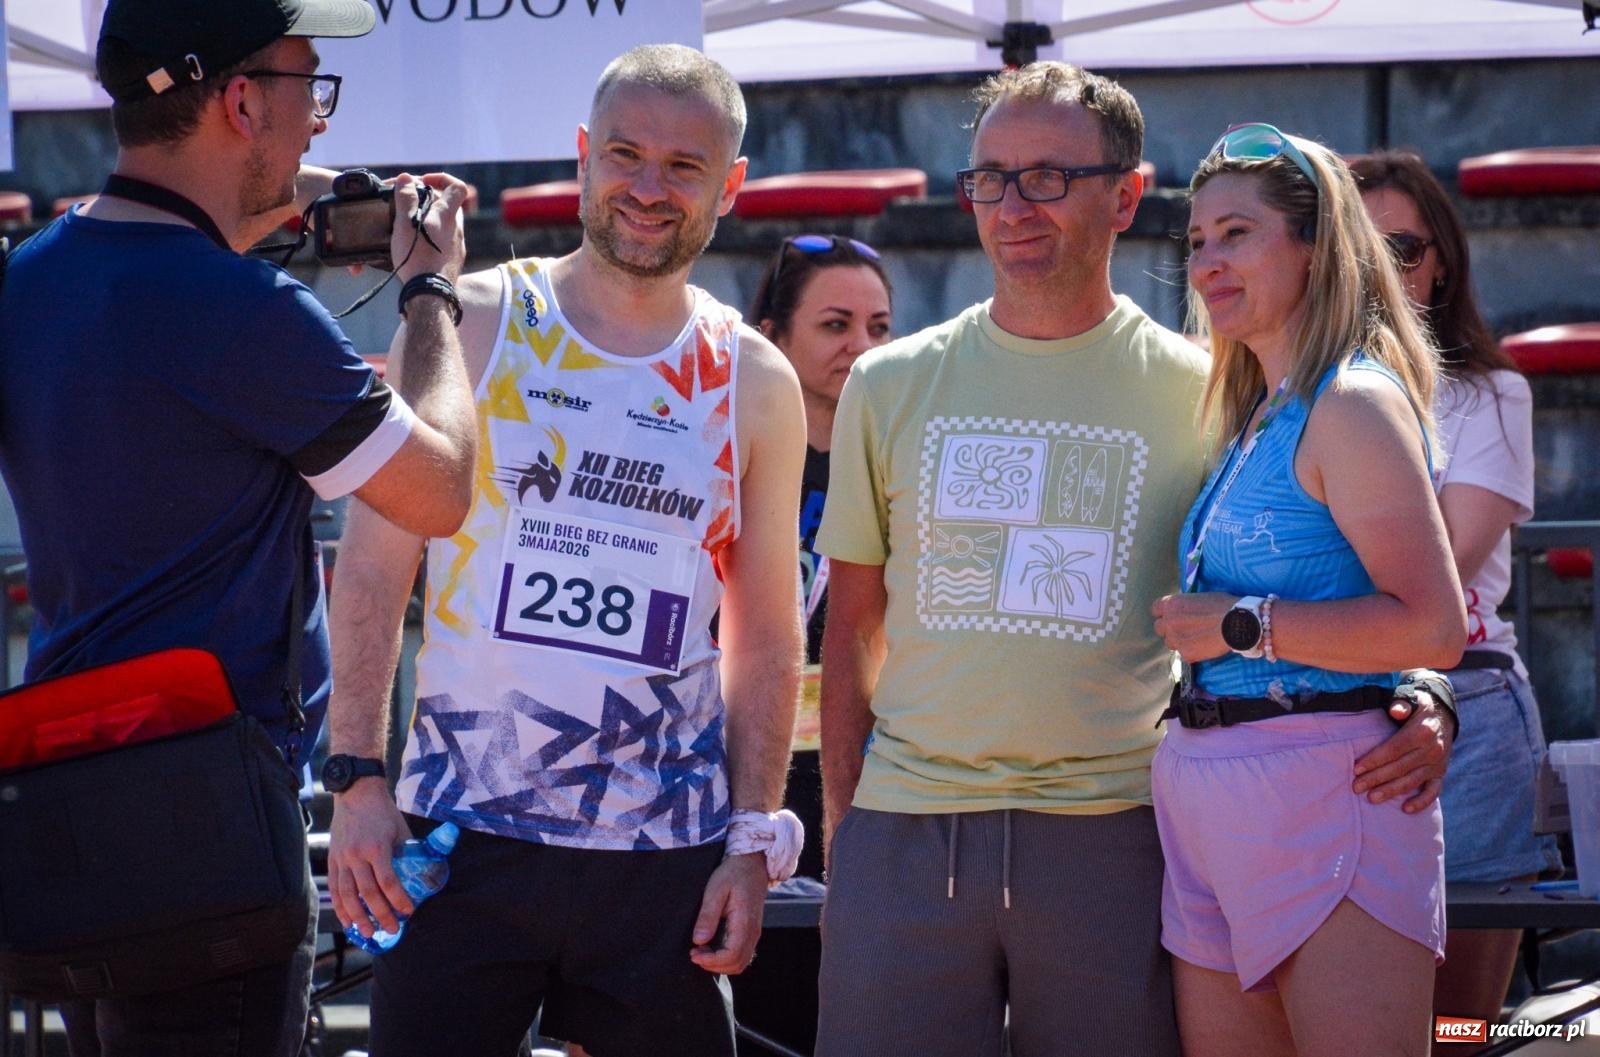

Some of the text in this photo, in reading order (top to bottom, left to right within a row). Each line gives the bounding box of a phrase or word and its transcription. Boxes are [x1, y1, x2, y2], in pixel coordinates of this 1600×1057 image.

[523, 289, 539, 327] deep
[577, 450, 665, 486] XII BIEG
[568, 472, 705, 522] KOZIOŁKÓW
[518, 534, 590, 558] 3MAJA2026
[520, 518, 659, 556] XVIII BIEG BEZ GRANIC
[519, 571, 635, 636] 238
